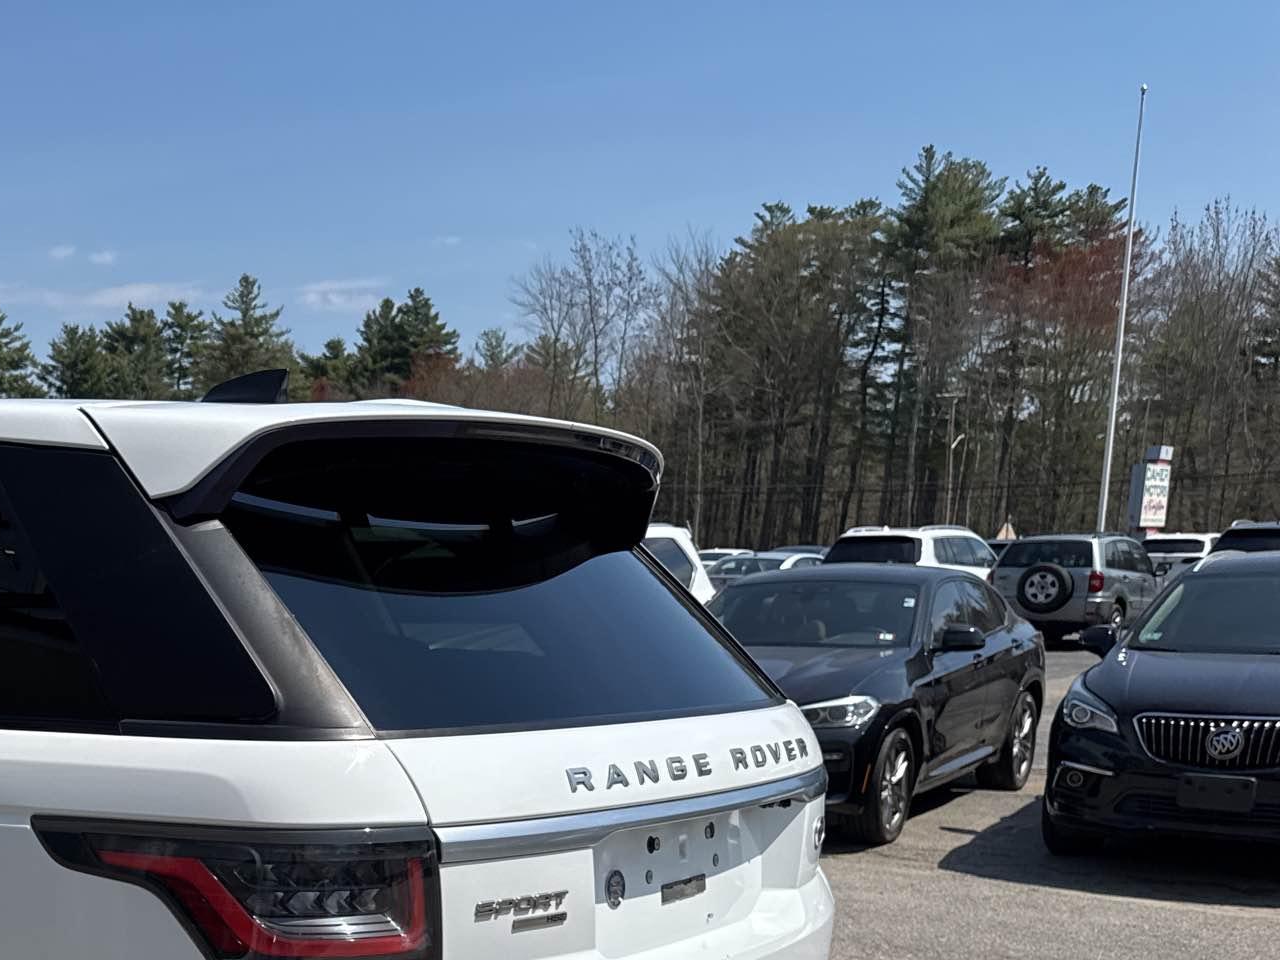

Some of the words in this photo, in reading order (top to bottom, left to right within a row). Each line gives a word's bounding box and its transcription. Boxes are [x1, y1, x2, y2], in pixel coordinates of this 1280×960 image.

[565, 752, 713, 794] RANGE
[729, 737, 809, 771] ROVER
[473, 890, 569, 923] SPORT
